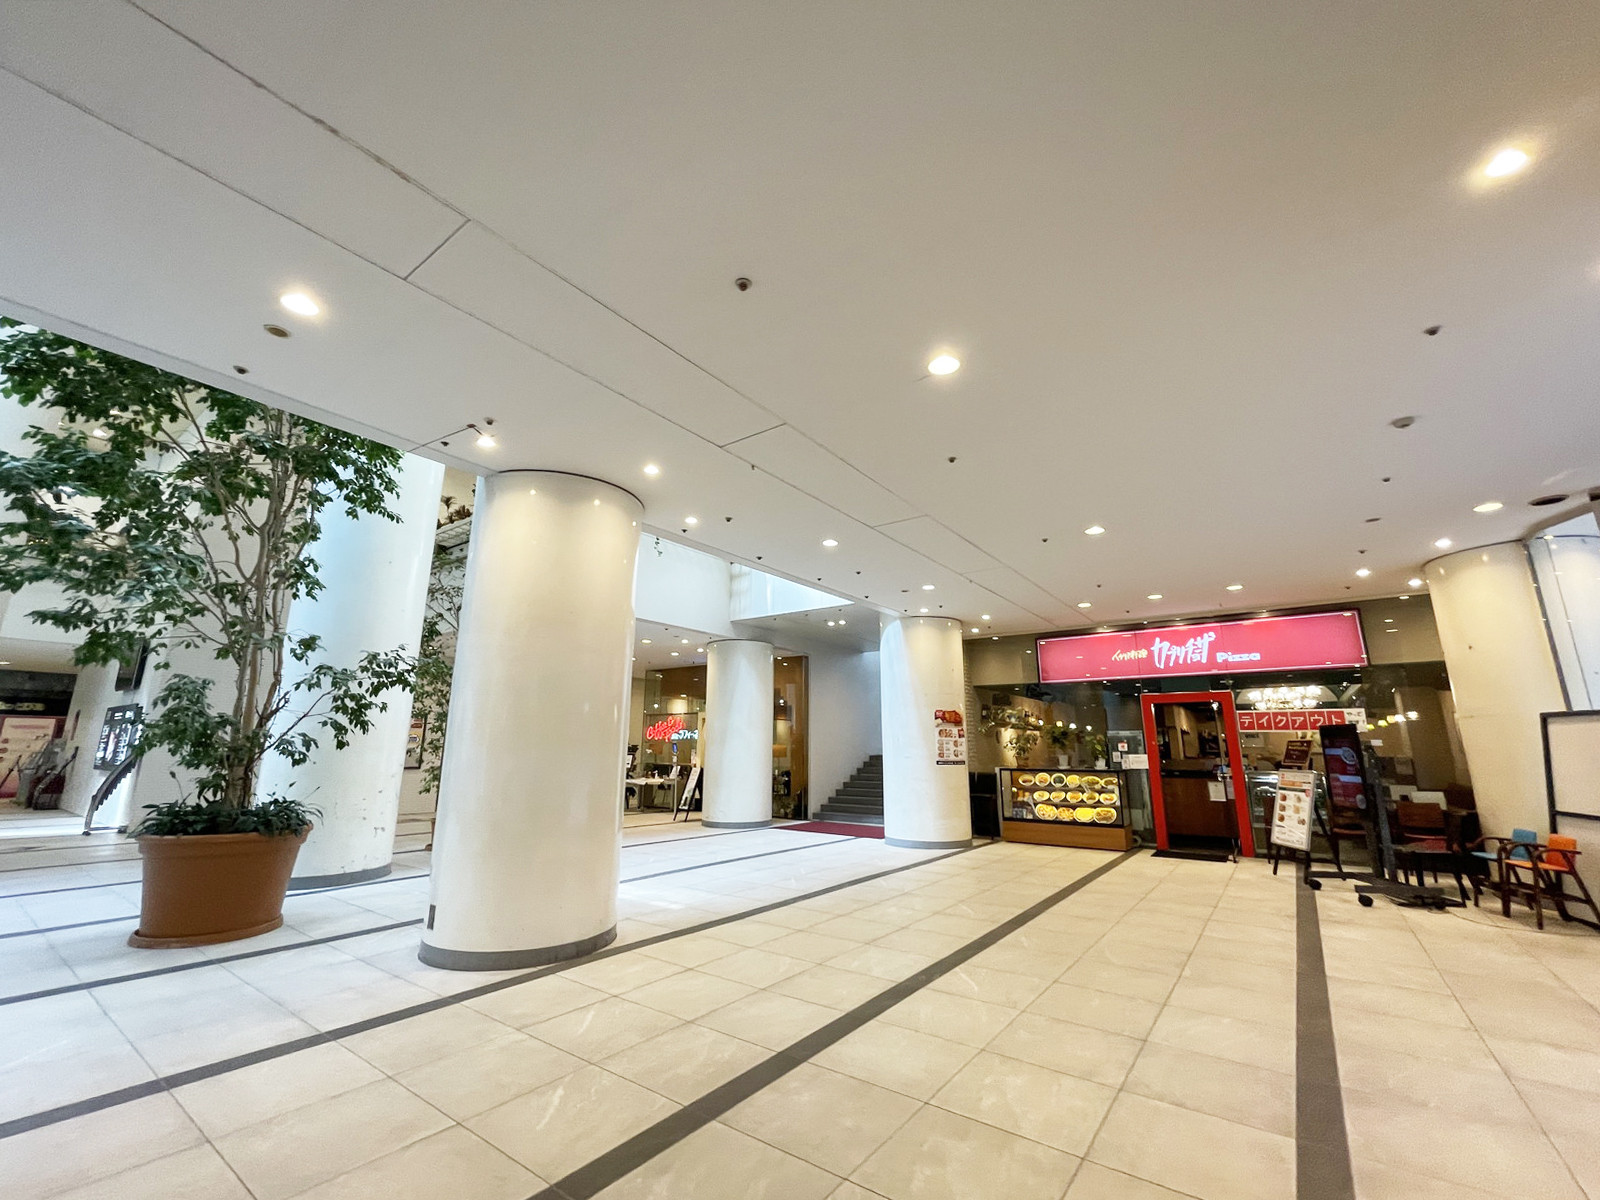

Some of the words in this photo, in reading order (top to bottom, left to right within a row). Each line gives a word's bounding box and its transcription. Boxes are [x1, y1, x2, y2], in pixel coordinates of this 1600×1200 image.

[1216, 651, 1261, 663] Pizza
[1239, 713, 1343, 728] テイクアウト
